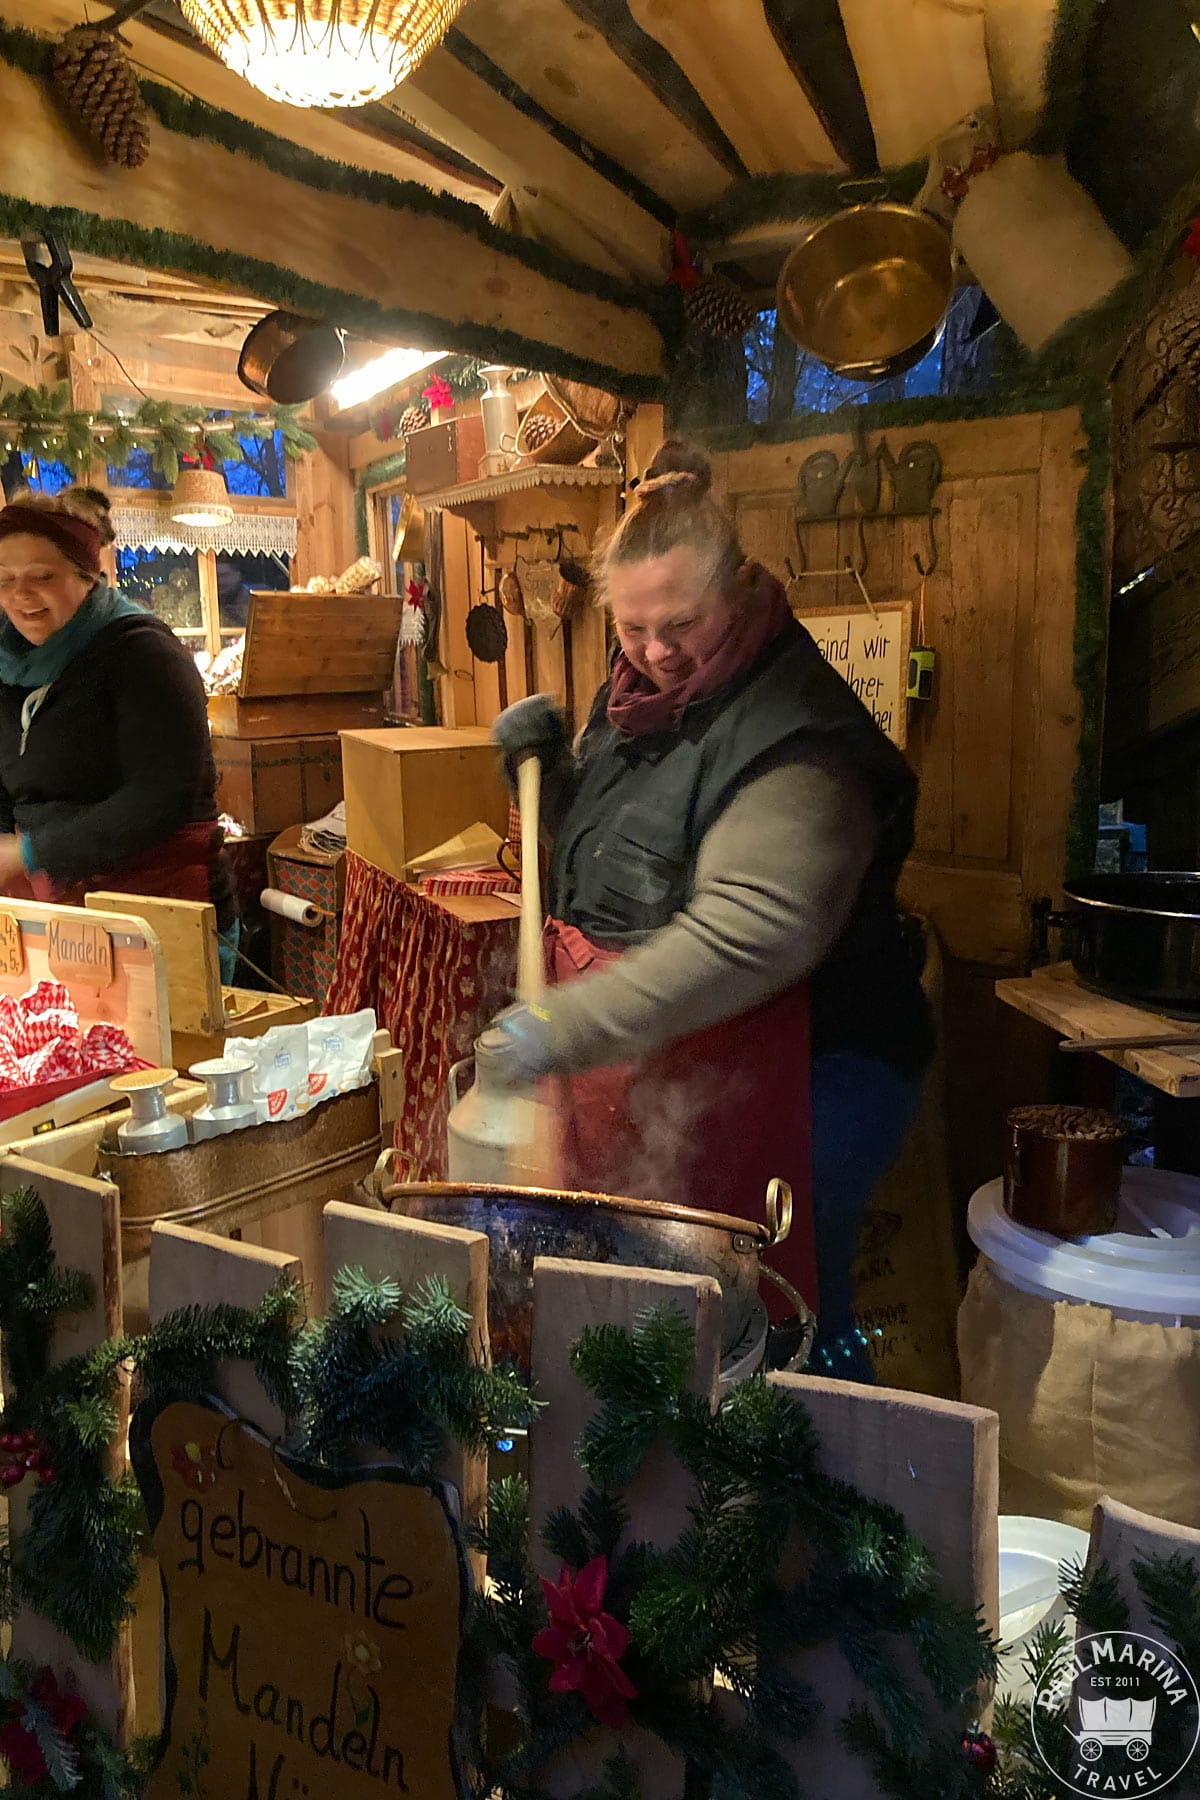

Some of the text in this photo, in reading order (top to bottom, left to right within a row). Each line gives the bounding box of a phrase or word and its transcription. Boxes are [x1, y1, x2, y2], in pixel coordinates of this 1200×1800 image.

[863, 624, 891, 659] wir
[50, 921, 108, 966] Mandeln
[177, 1488, 414, 1629] gebrannte
[199, 1607, 409, 1792] Mandeln
